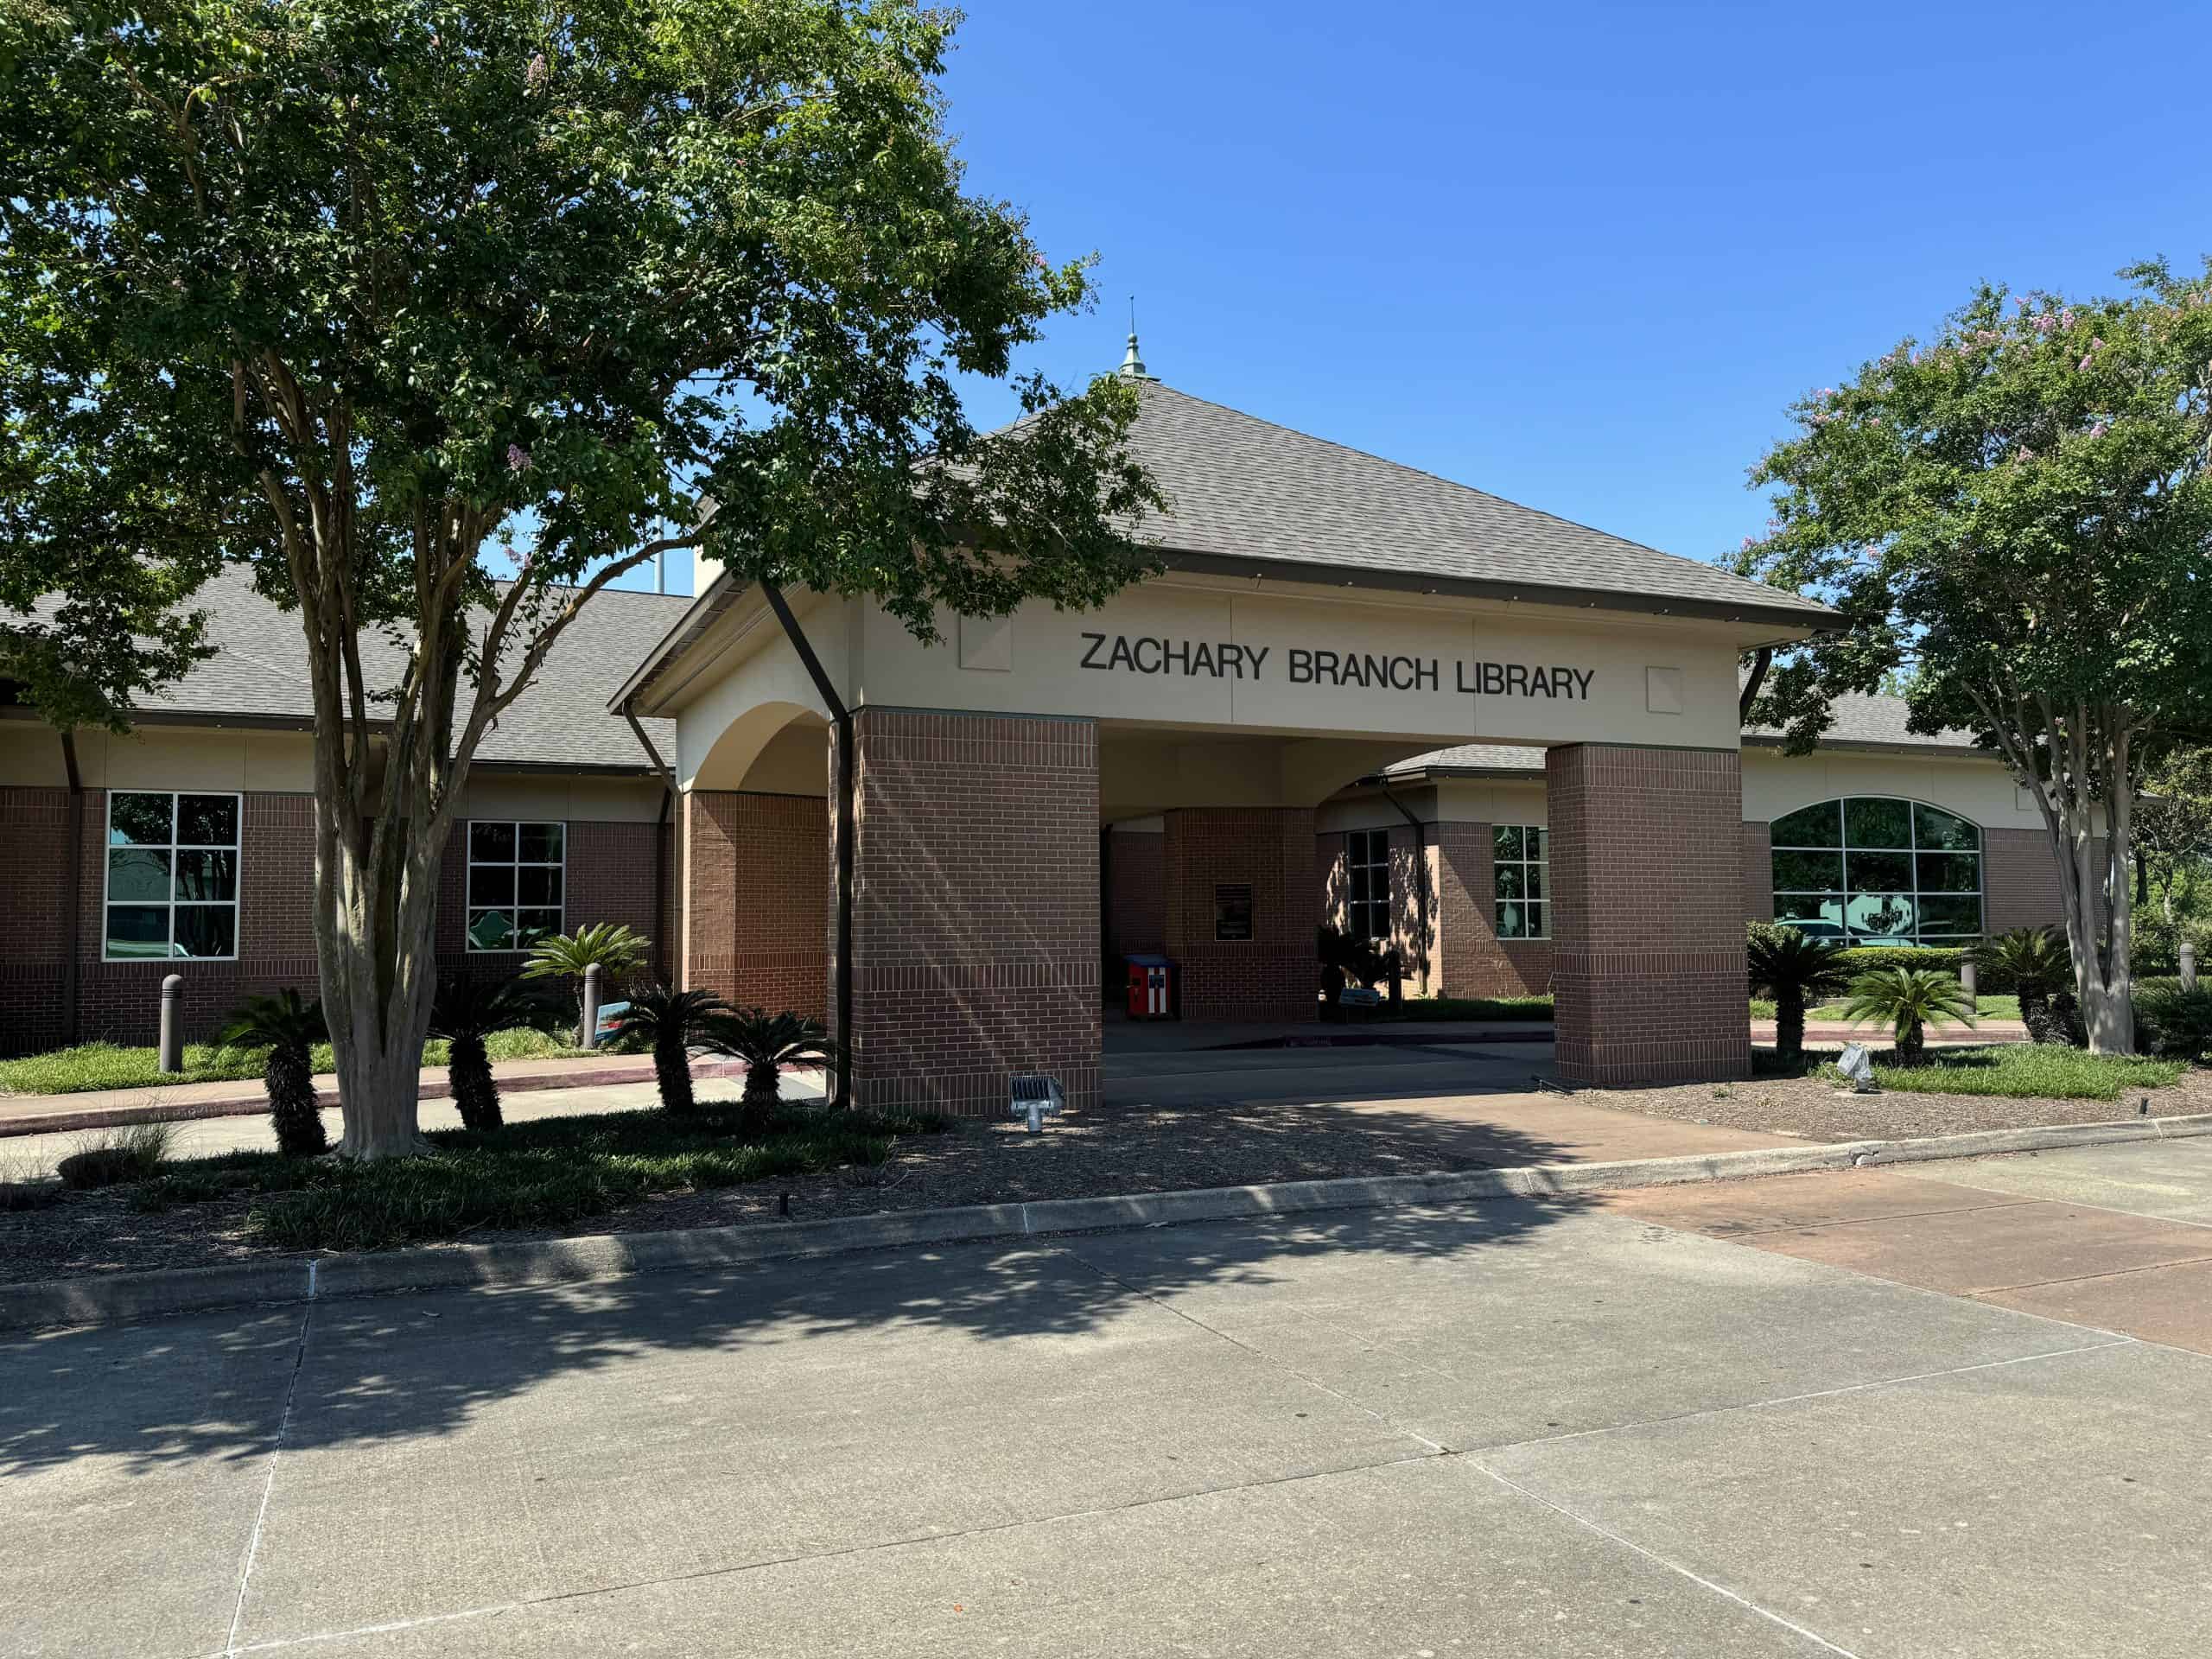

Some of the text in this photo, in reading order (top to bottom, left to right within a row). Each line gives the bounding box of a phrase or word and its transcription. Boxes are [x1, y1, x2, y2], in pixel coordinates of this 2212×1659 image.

[1080, 632, 1595, 700] ZACHARY BRANCH LIBRARY
